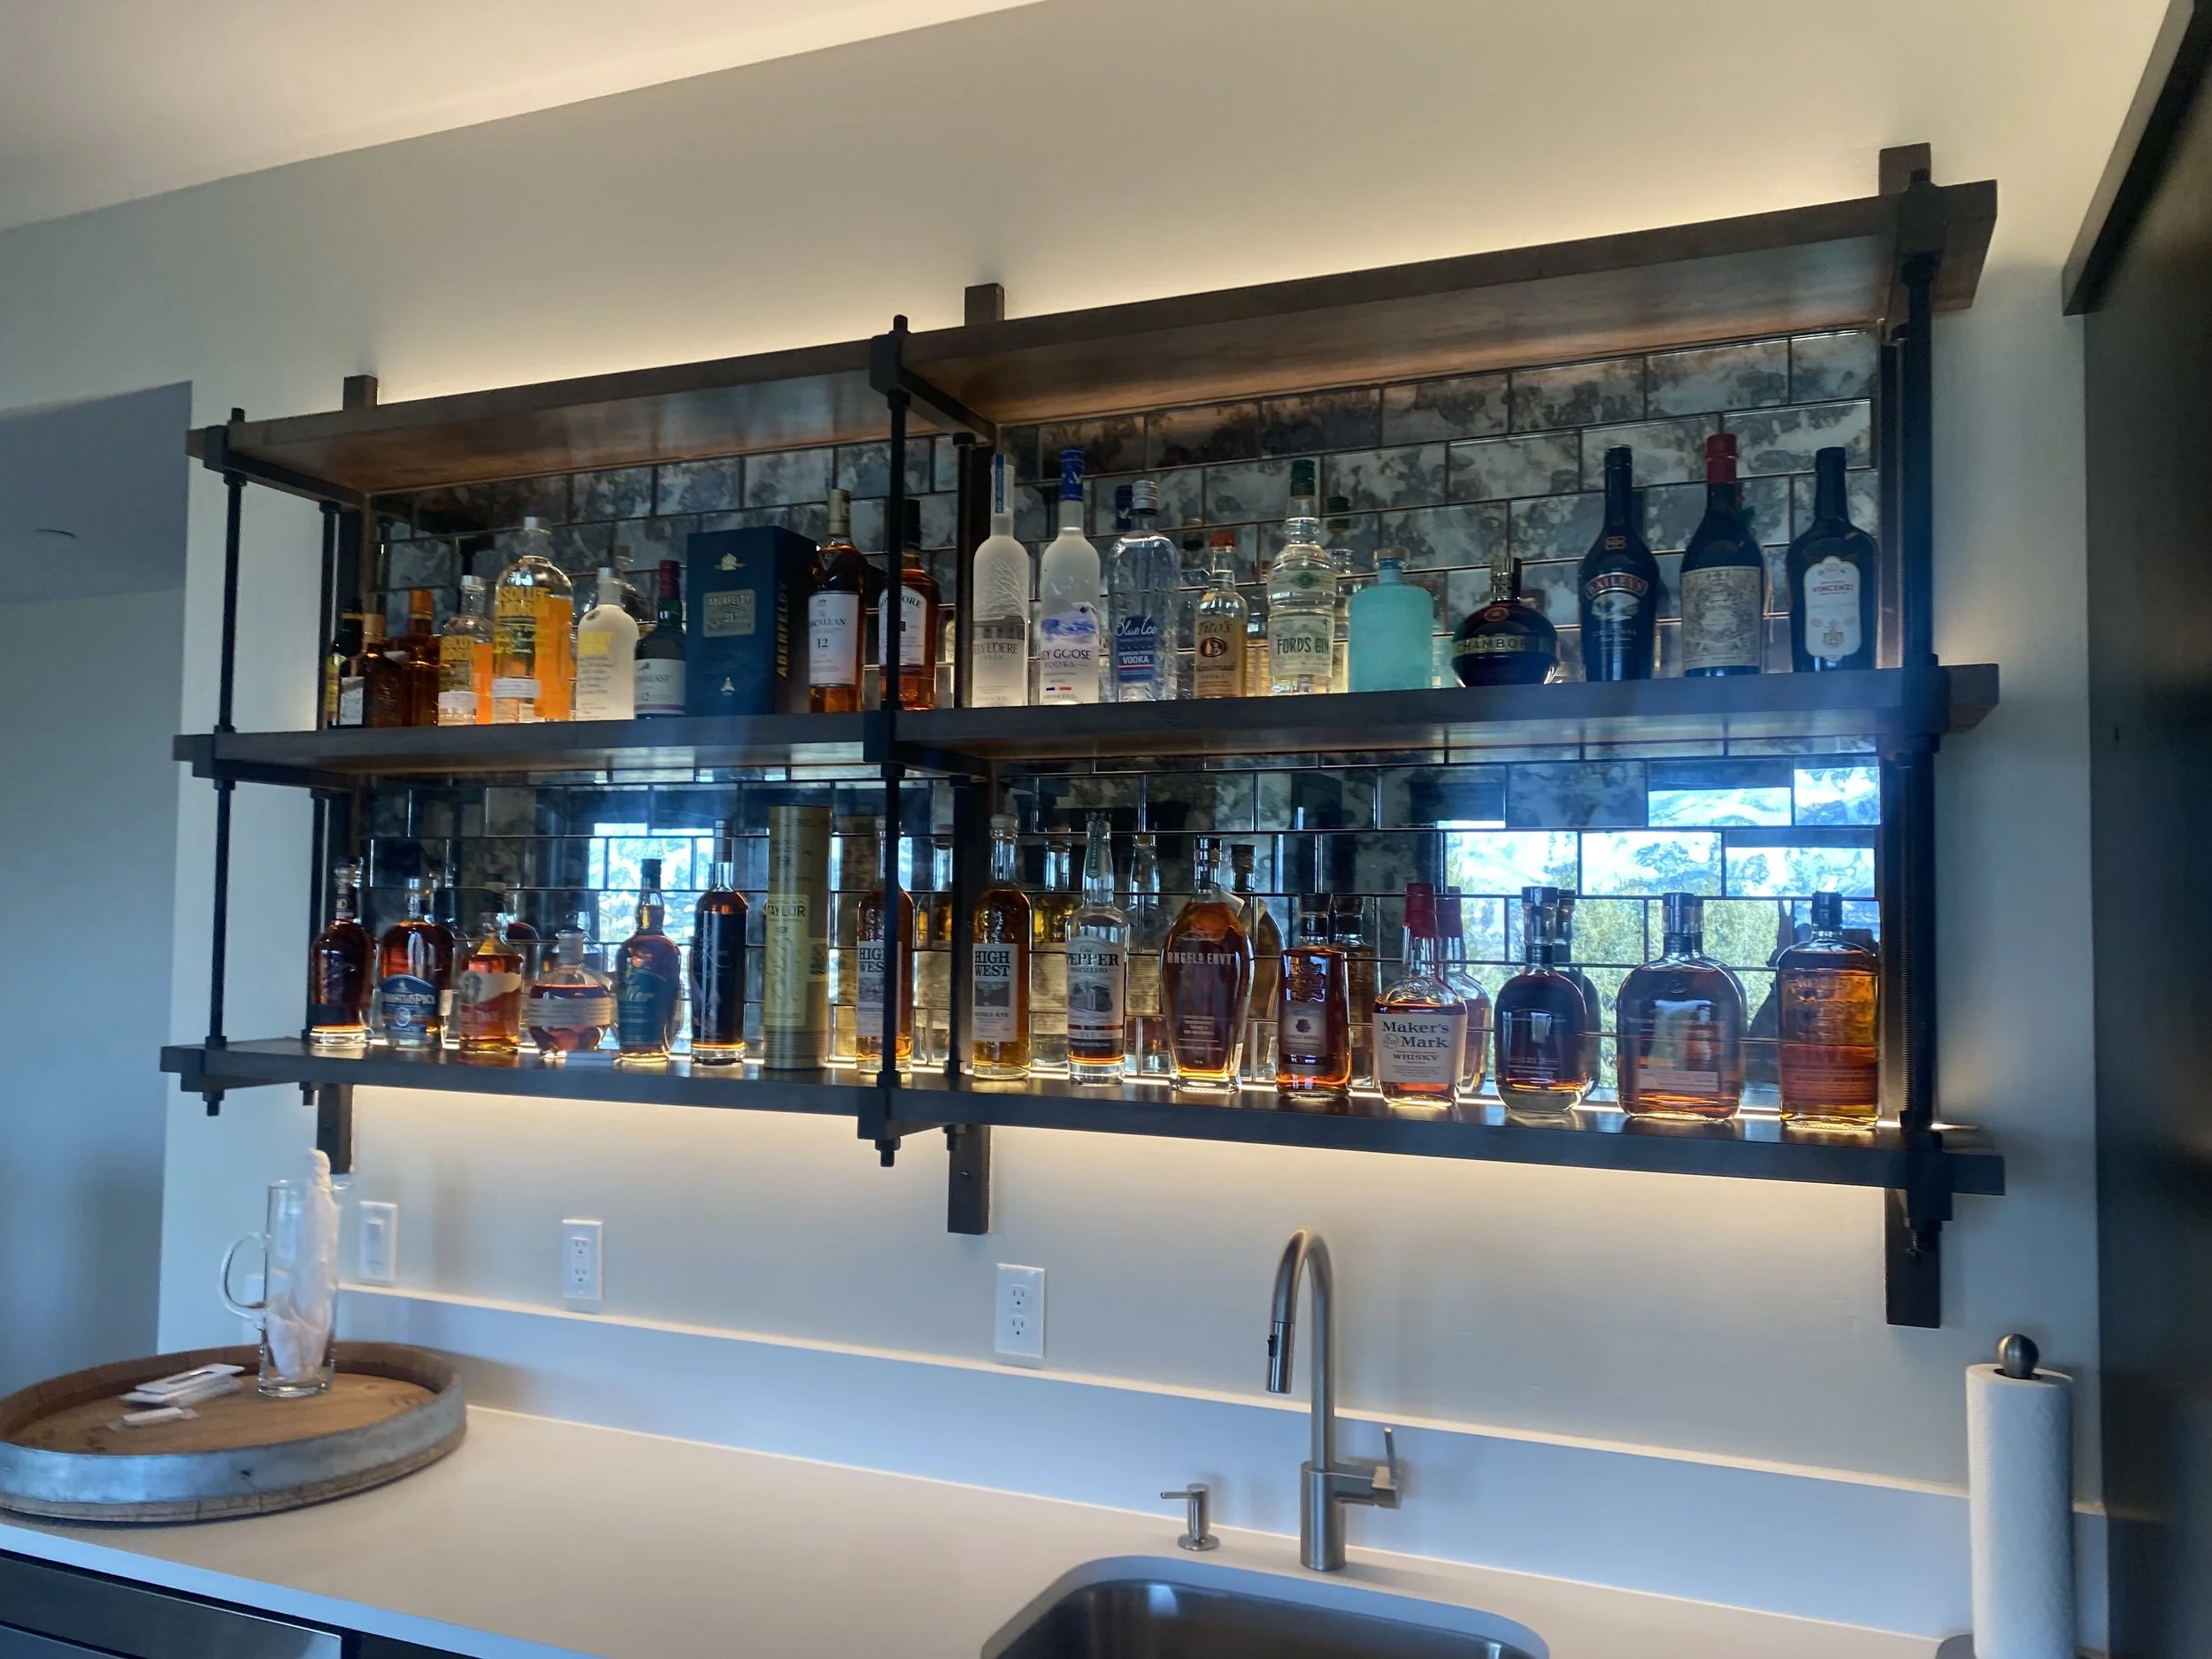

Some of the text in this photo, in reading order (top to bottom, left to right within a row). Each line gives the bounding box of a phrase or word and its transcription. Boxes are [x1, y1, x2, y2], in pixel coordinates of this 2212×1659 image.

[1115, 613, 1158, 637] Blue Ice
[816, 637, 828, 649] 12
[1277, 637, 1330, 655] FORDS GIN
[1053, 649, 1091, 660] GOOSE
[1122, 655, 1150, 664] VODKA
[859, 948, 885, 961] HIG
[974, 950, 1010, 964] HIGH
[1207, 952, 1232, 965] ENVY
[859, 961, 885, 973] WES
[974, 964, 1010, 977] WEST
[1382, 1021, 1449, 1033] Maker's
[1401, 1036, 1449, 1048] Mark
